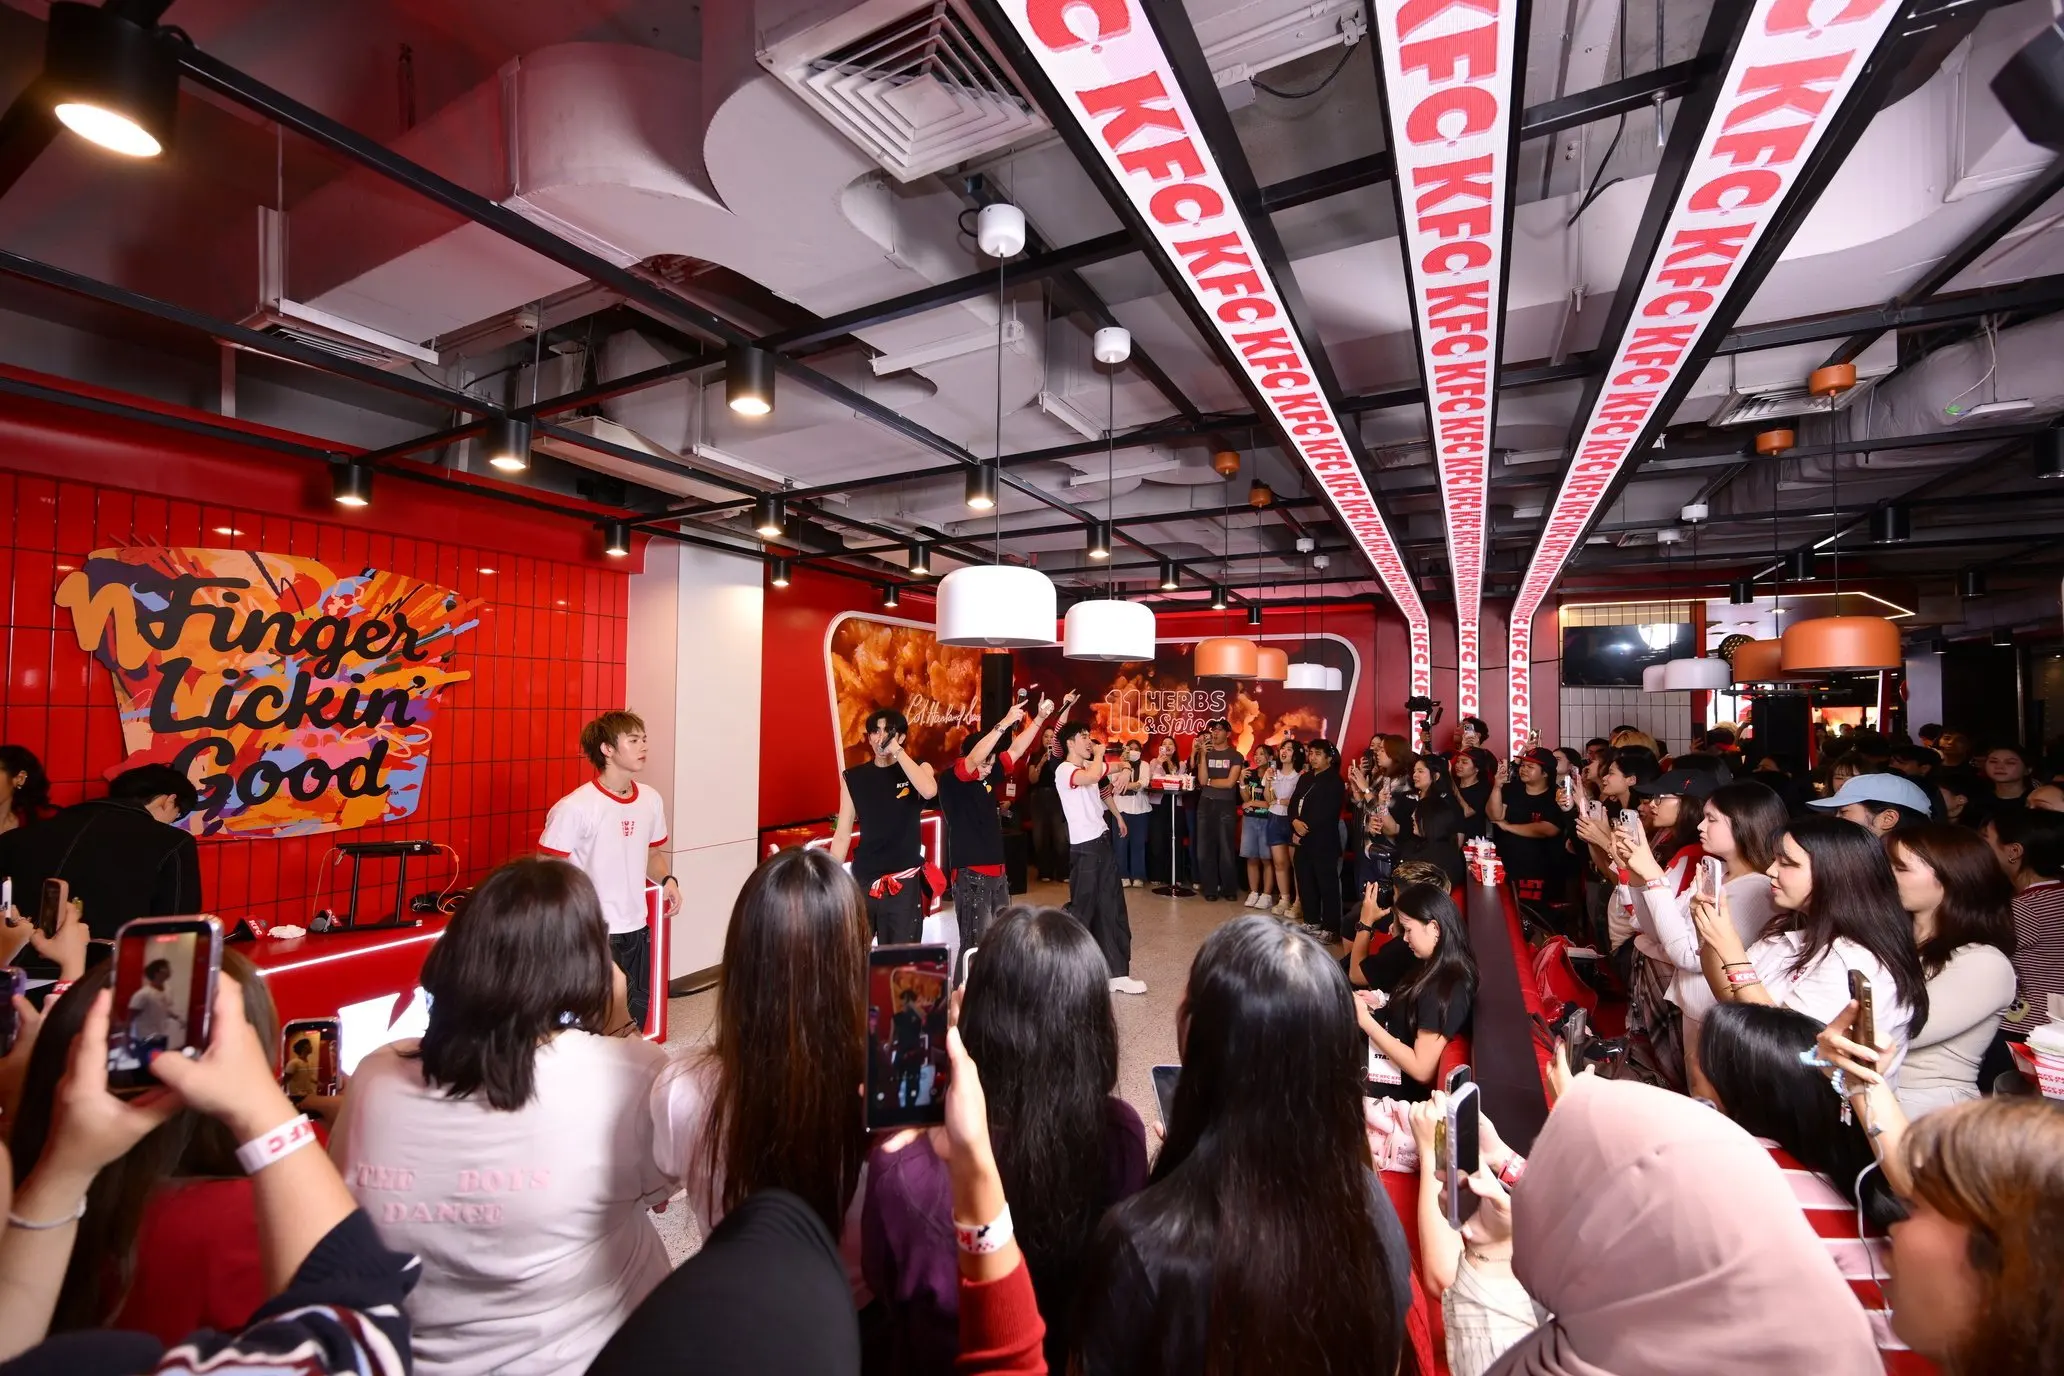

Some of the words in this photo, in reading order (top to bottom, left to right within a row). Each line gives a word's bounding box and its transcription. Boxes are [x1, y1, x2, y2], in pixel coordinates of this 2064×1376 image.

[1687, 48, 1857, 214] KFC
[1075, 71, 1226, 227] KFC
[1411, 153, 1495, 276] KFC
[1172, 231, 1278, 325] KFC
[1642, 222, 1757, 318] KFC
[1425, 279, 1490, 358] KFC
[1231, 327, 1312, 390] KFC
[1611, 323, 1699, 387] KFC
[1433, 359, 1487, 414] KFC
[1271, 391, 1335, 437] KFC
[1590, 390, 1660, 435] KFC
[1440, 415, 1485, 455] KFC
[1300, 437, 1353, 471] KFC
[1444, 455, 1484, 486] KFC
[1574, 437, 1631, 472] KFC
[1321, 472, 1366, 498] KFC
[1448, 486, 1483, 511] KFC
[1562, 472, 1611, 499] KFC
[1338, 499, 1377, 520] KFC
[1451, 510, 1482, 530] KFC
[1553, 500, 1596, 521] KFC
[1352, 520, 1386, 538] KFC
[1453, 529, 1481, 546] KFC
[1546, 521, 1583, 538] KFC
[135, 574, 428, 679] Finger
[1511, 627, 1528, 661] KFC
[1412, 632, 1429, 665] KFC
[1461, 630, 1477, 663] KFC
[149, 658, 427, 733] Lickin'
[1414, 669, 1429, 696] KF
[1461, 667, 1477, 707] KFC
[1511, 666, 1528, 707] KFC
[1105, 689, 1141, 734] 11
[1145, 690, 1227, 712] HERBS
[173, 737, 391, 822] Good
[1734, 972, 1757, 981] KFC
[356, 1163, 416, 1192] THE
[383, 1201, 504, 1225] DANCE
